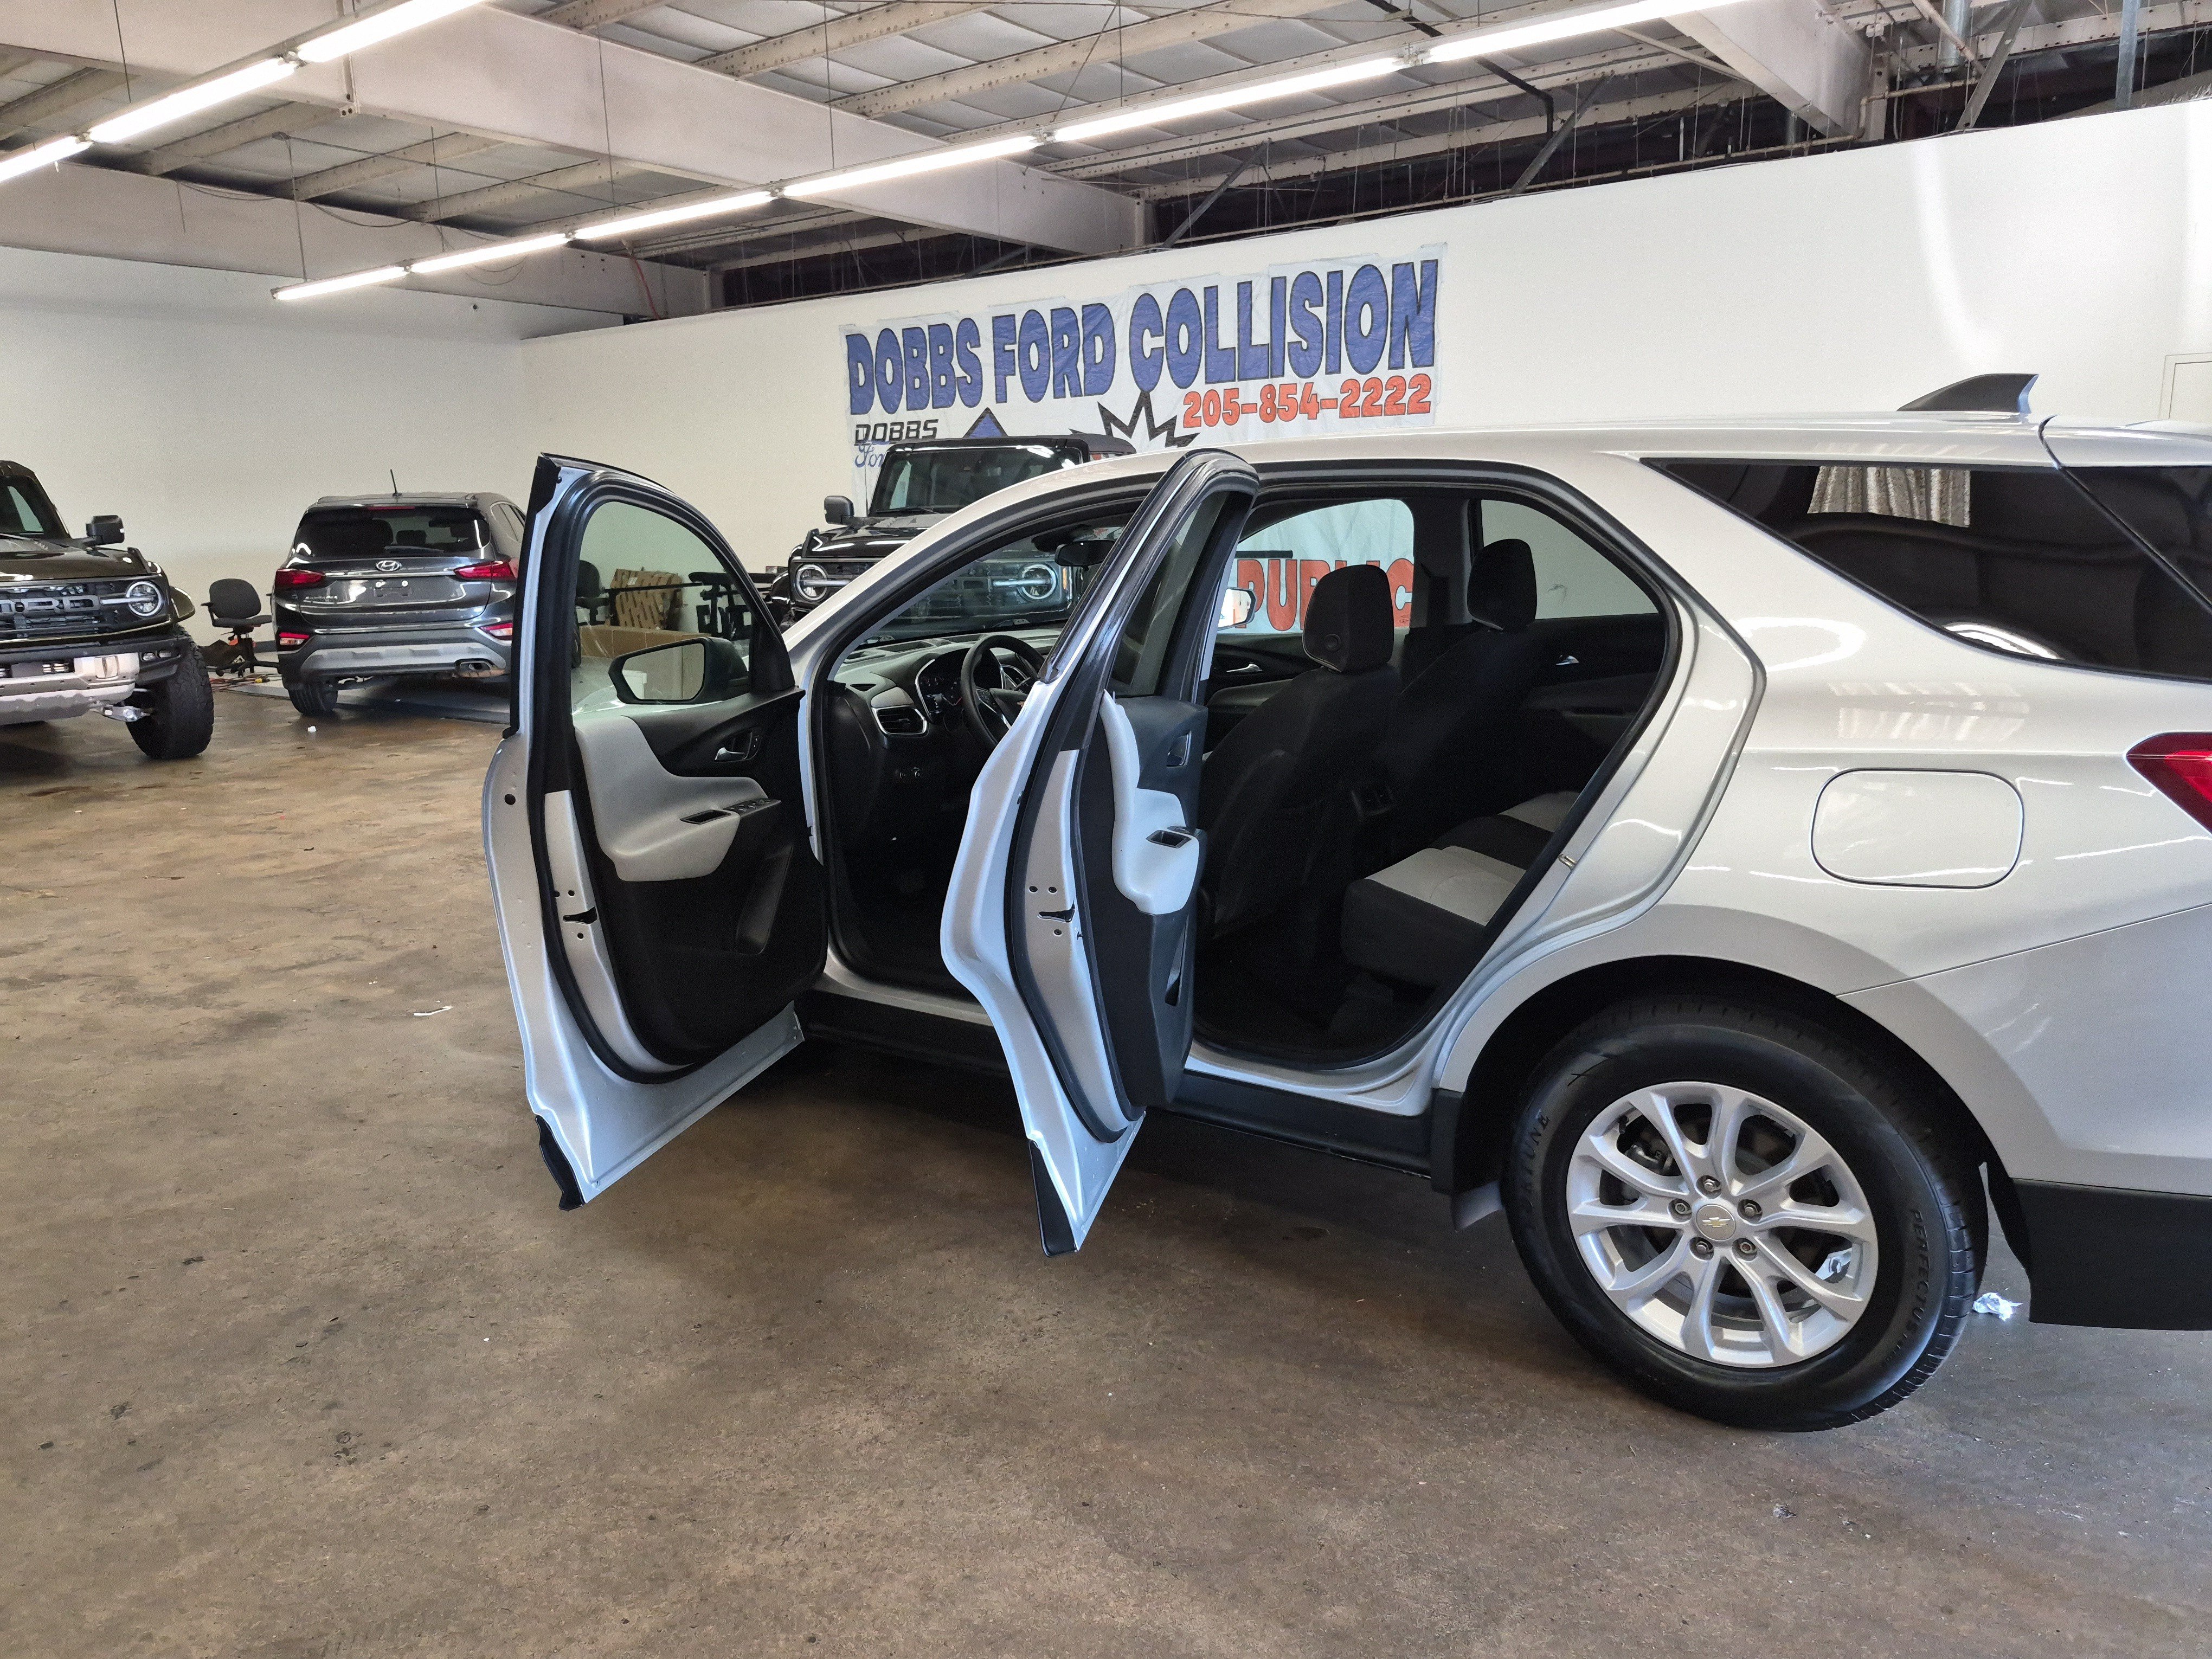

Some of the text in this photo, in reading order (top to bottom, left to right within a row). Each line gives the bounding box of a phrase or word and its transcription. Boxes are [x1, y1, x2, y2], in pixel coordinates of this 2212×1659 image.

[846, 259, 1438, 415] DOBBS FORD COLLISION
[1183, 374, 1432, 428] 205-854-2222
[854, 419, 939, 442] DOBBS
[854, 440, 887, 468] For
